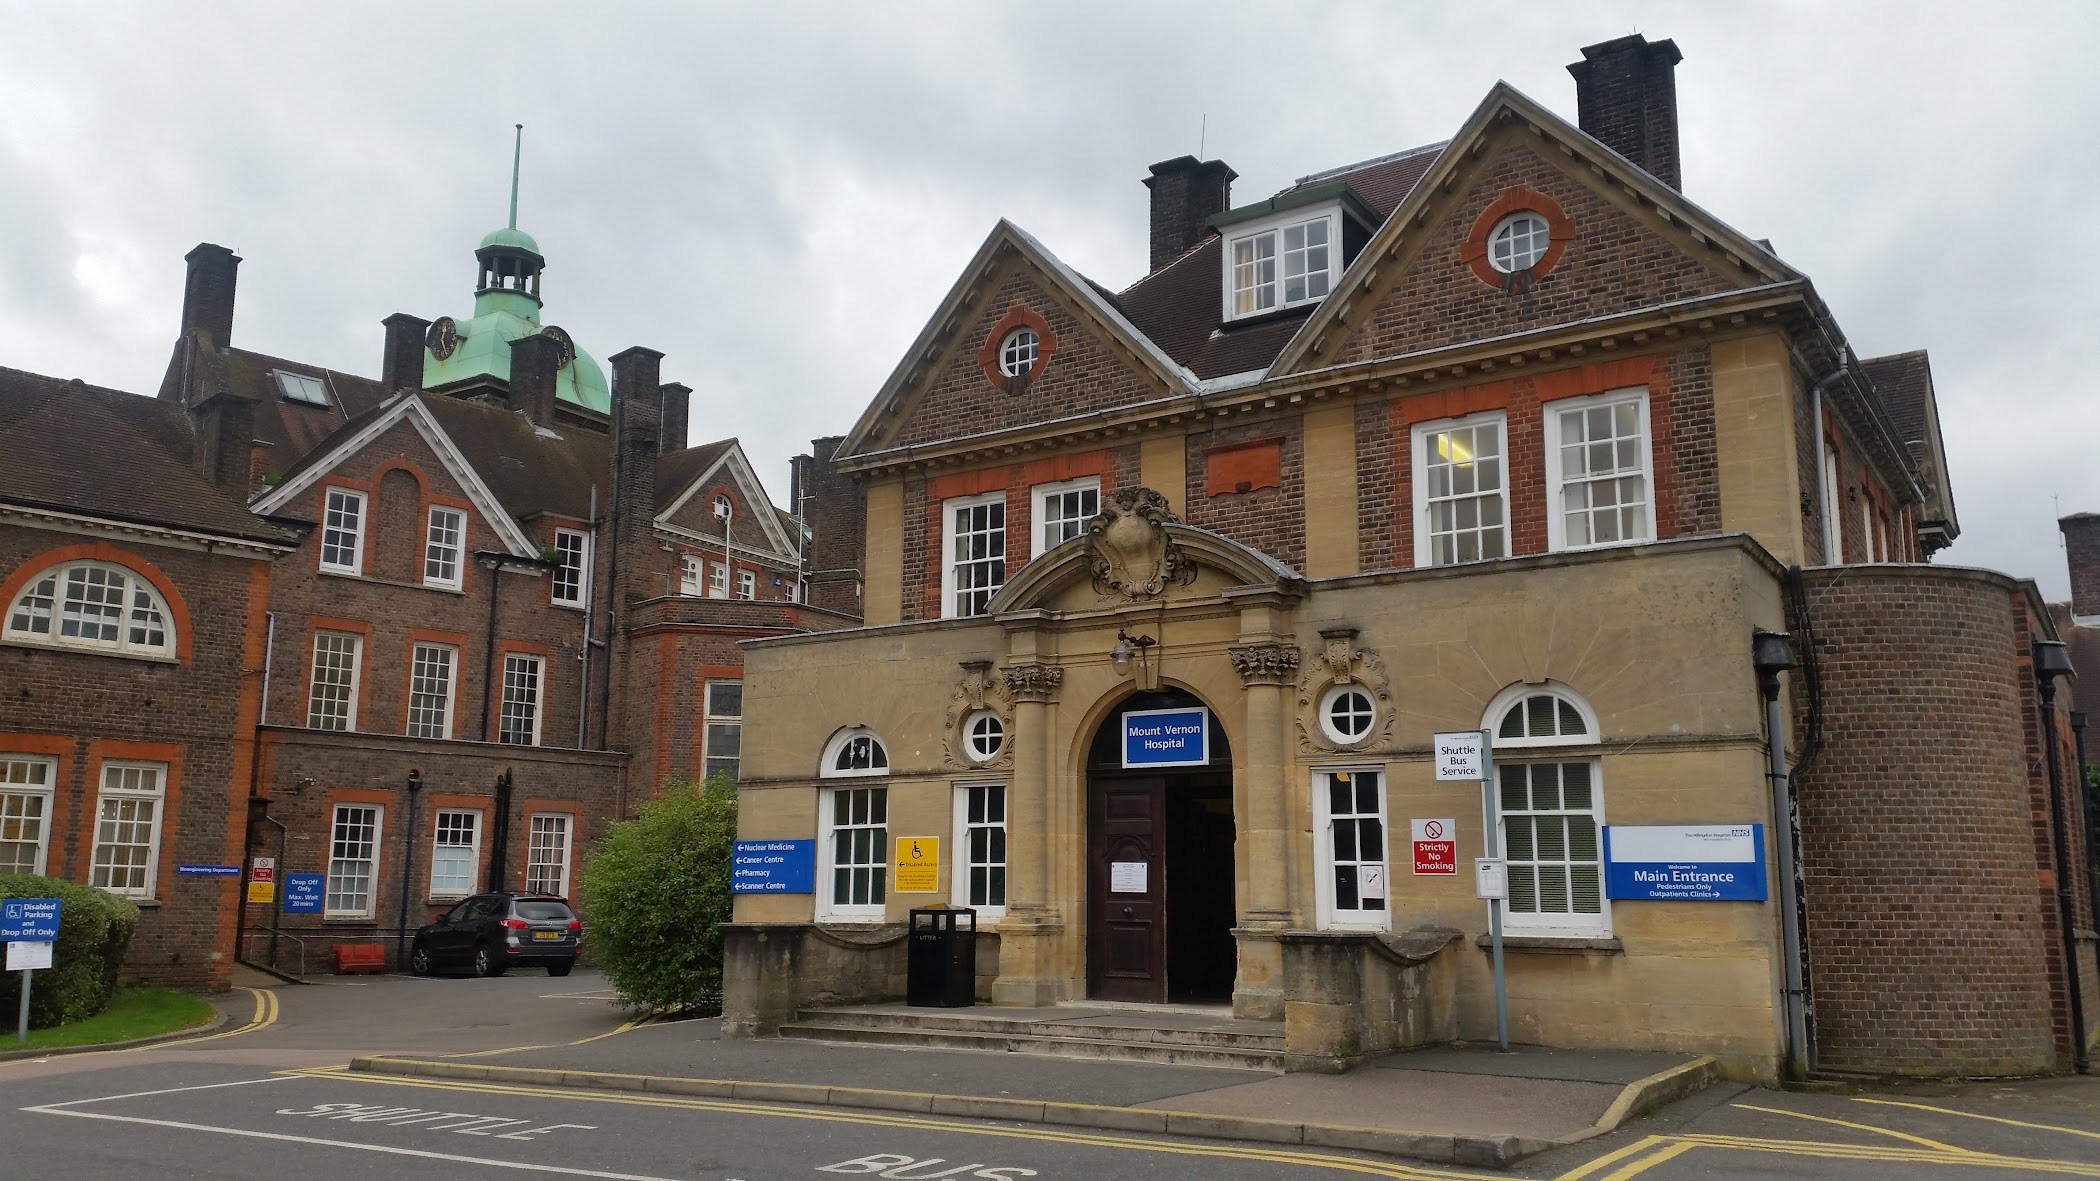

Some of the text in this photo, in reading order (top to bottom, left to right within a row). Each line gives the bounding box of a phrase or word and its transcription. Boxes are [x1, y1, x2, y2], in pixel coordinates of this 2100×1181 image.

[1129, 725, 1200, 736] Mount Vernon
[1144, 738, 1184, 751] Hospital
[1441, 745, 1476, 755] Shuttle
[1450, 756, 1467, 765] Bus
[1442, 766, 1477, 776] Service
[744, 842, 795, 851] Nuclear Medicine
[1419, 843, 1449, 853] Strictly
[742, 855, 784, 864] Cancer Centre
[1428, 852, 1441, 860] No
[1416, 861, 1454, 872] Smoking
[741, 869, 771, 878] Pharmacy
[1634, 870, 1735, 882] Main Entrance
[741, 882, 764, 890] Scanner
[1696, 883, 1712, 891] Only
[1649, 890, 1712, 898] Outpatients Clinics
[24, 911, 53, 919] Parking
[1, 929, 20, 937] Drop
[37, 928, 56, 937] Only
[275, 1103, 598, 1140] SHUTTLE
[815, 1153, 1038, 1181] BUS
